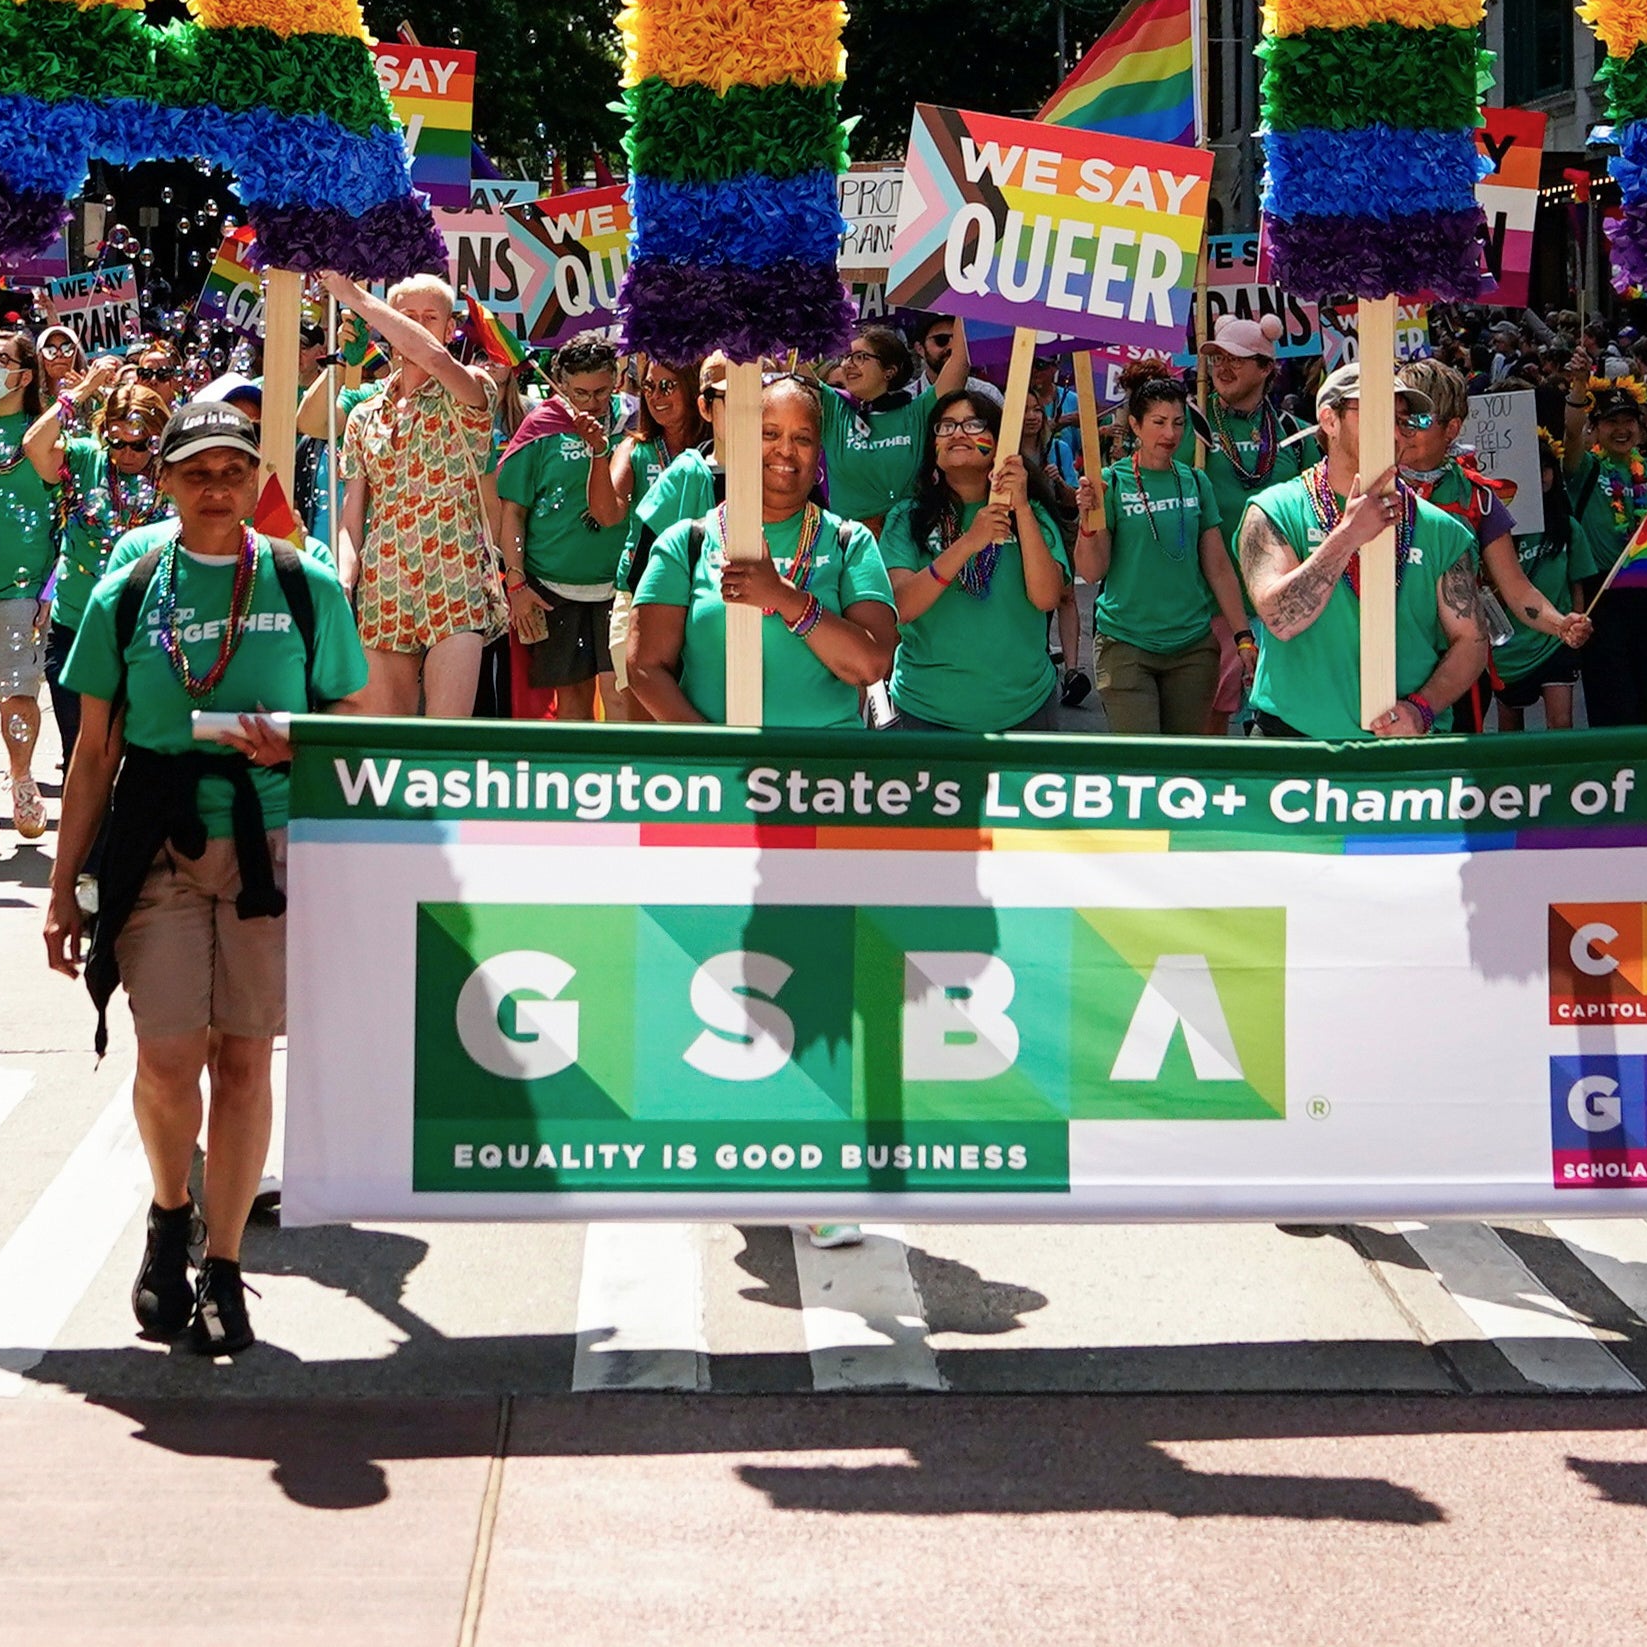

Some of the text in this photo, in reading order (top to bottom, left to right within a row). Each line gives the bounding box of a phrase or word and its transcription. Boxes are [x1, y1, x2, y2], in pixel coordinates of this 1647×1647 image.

[376, 56, 459, 94] SAY
[960, 137, 1200, 215] WE SAY
[839, 179, 902, 216] PROT
[541, 204, 617, 245] WE
[944, 202, 1183, 329] QUEER
[59, 278, 90, 300] WE
[1484, 395, 1513, 419] YOU
[1474, 428, 1513, 450] FEELS
[334, 758, 722, 822] Washington
[745, 767, 962, 816] State’s
[985, 772, 1247, 819] LGBTQ+
[1269, 777, 1552, 824] Chamber
[1570, 769, 1636, 815] of
[455, 949, 1247, 1083] GSBA
[1557, 1002, 1647, 1018] CAPITOL
[454, 1143, 1028, 1171] EQUALITY IS GOOD BUSINESS
